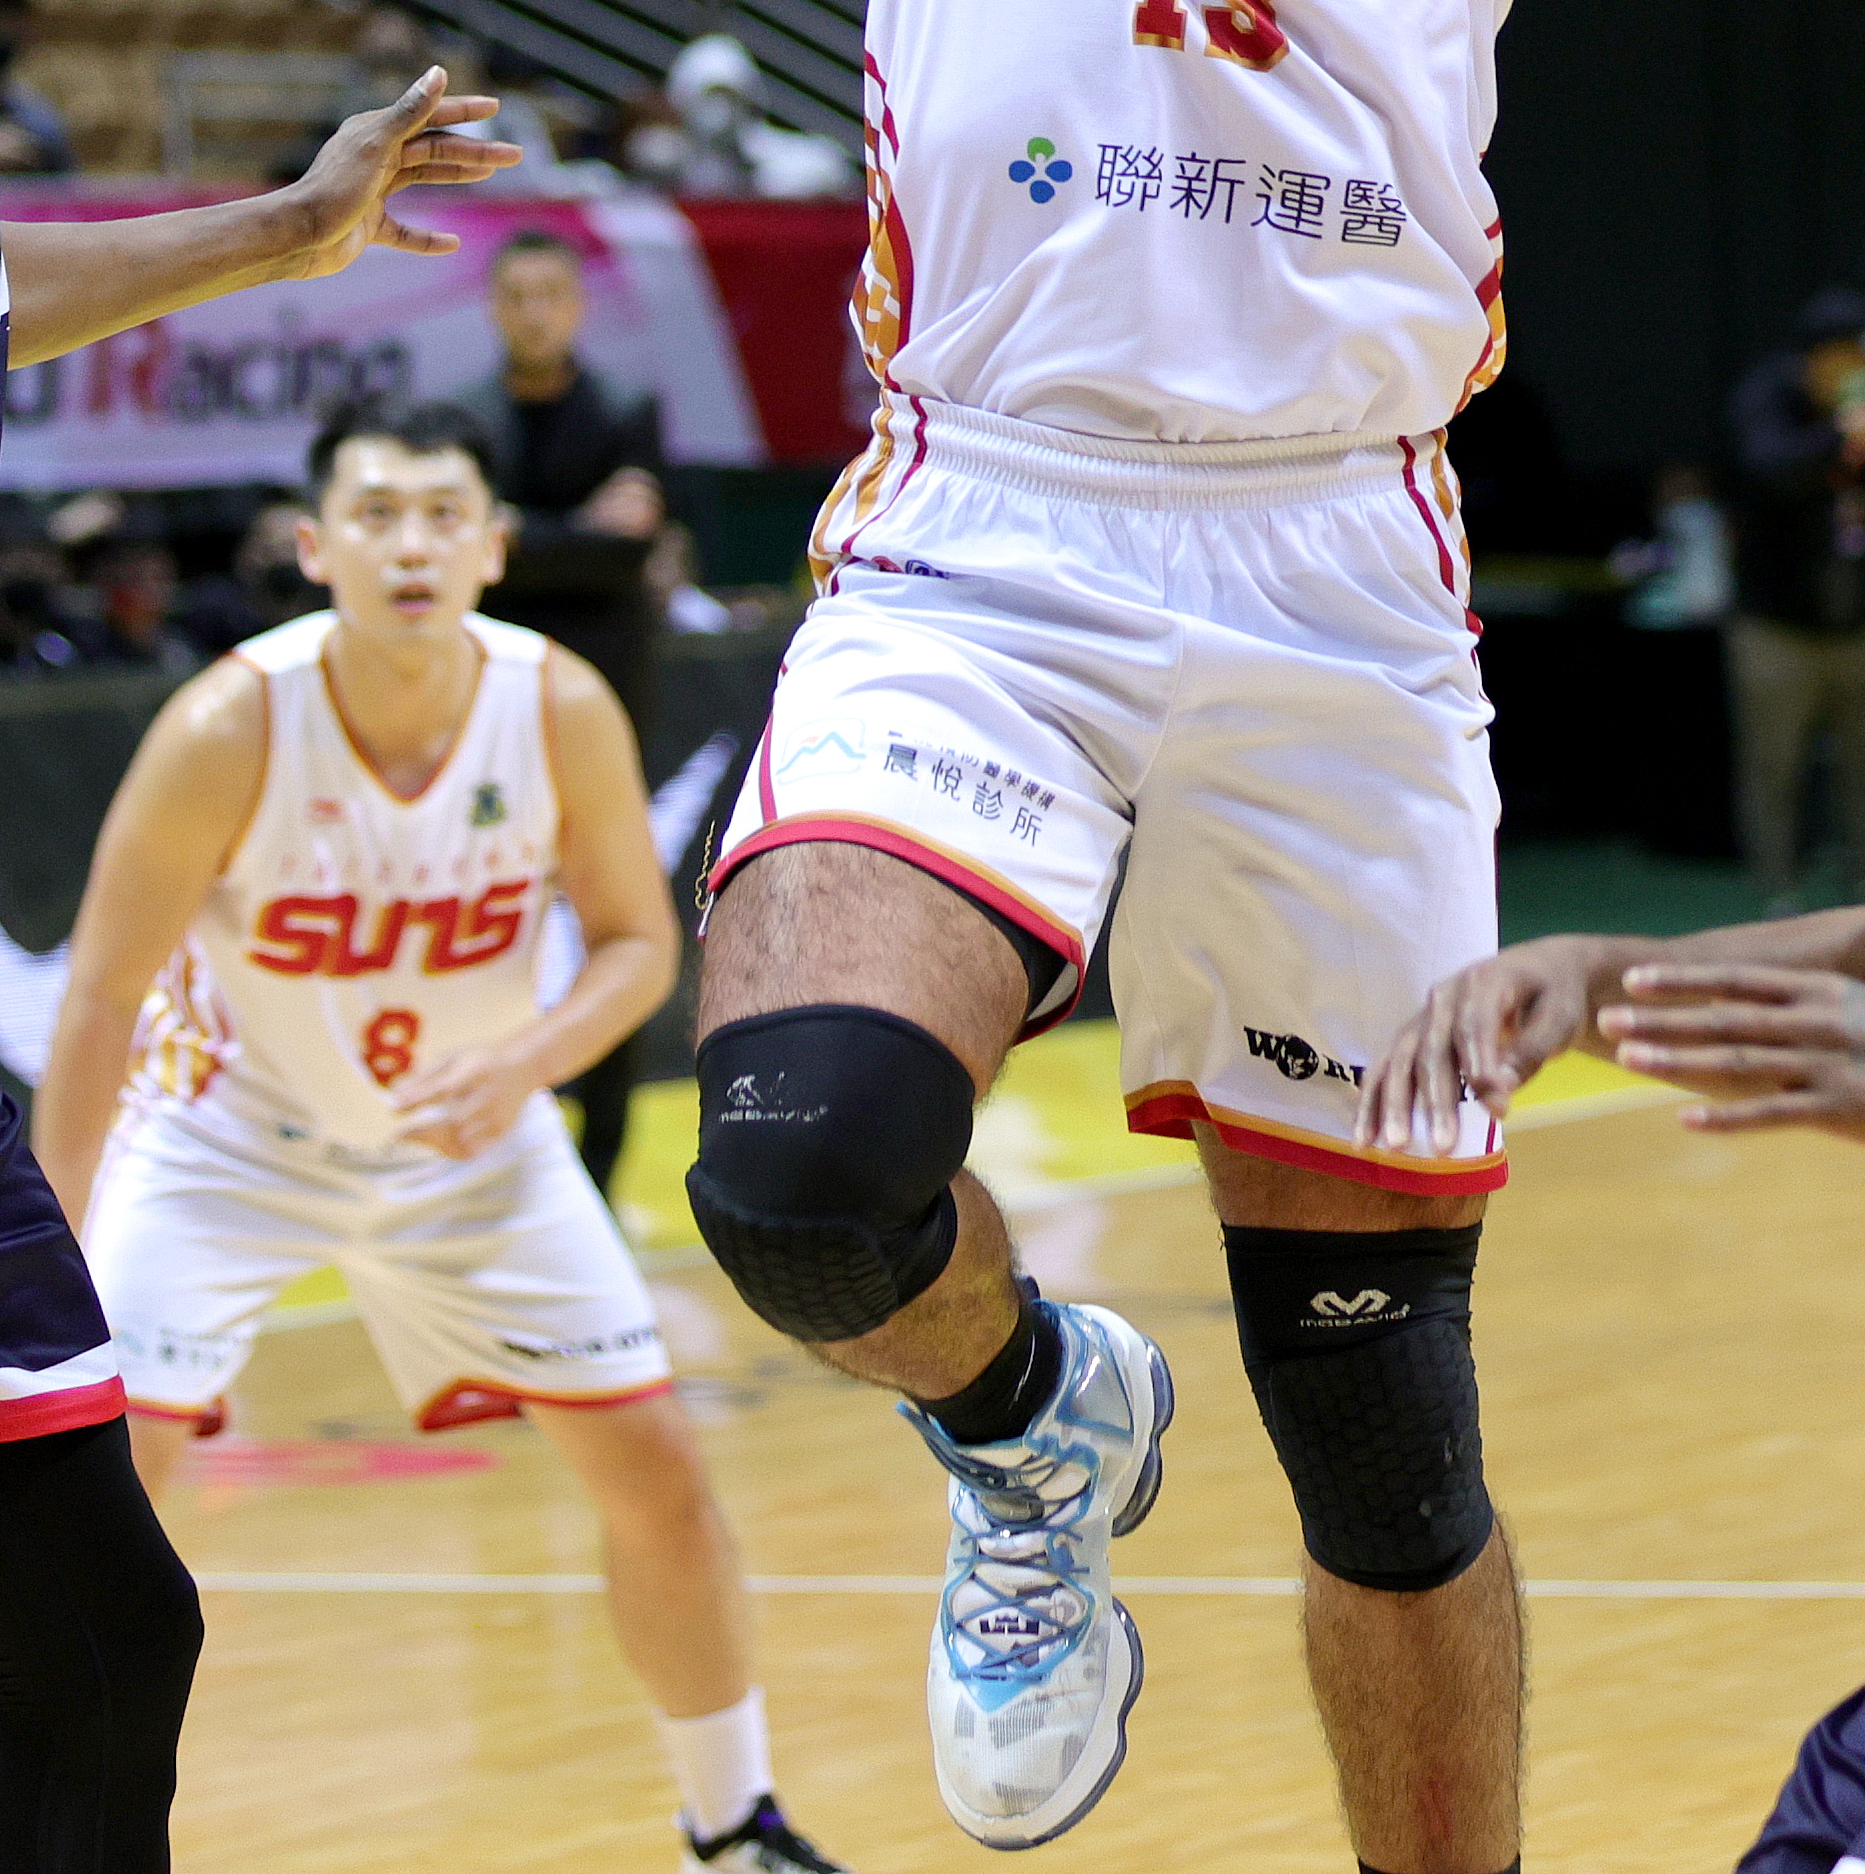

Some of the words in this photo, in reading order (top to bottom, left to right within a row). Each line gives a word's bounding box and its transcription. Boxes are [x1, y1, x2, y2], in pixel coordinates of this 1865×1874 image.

[1095, 143, 1407, 247] 聯新運醫
[247, 878, 530, 978] SUNS
[360, 1007, 422, 1087] 8
